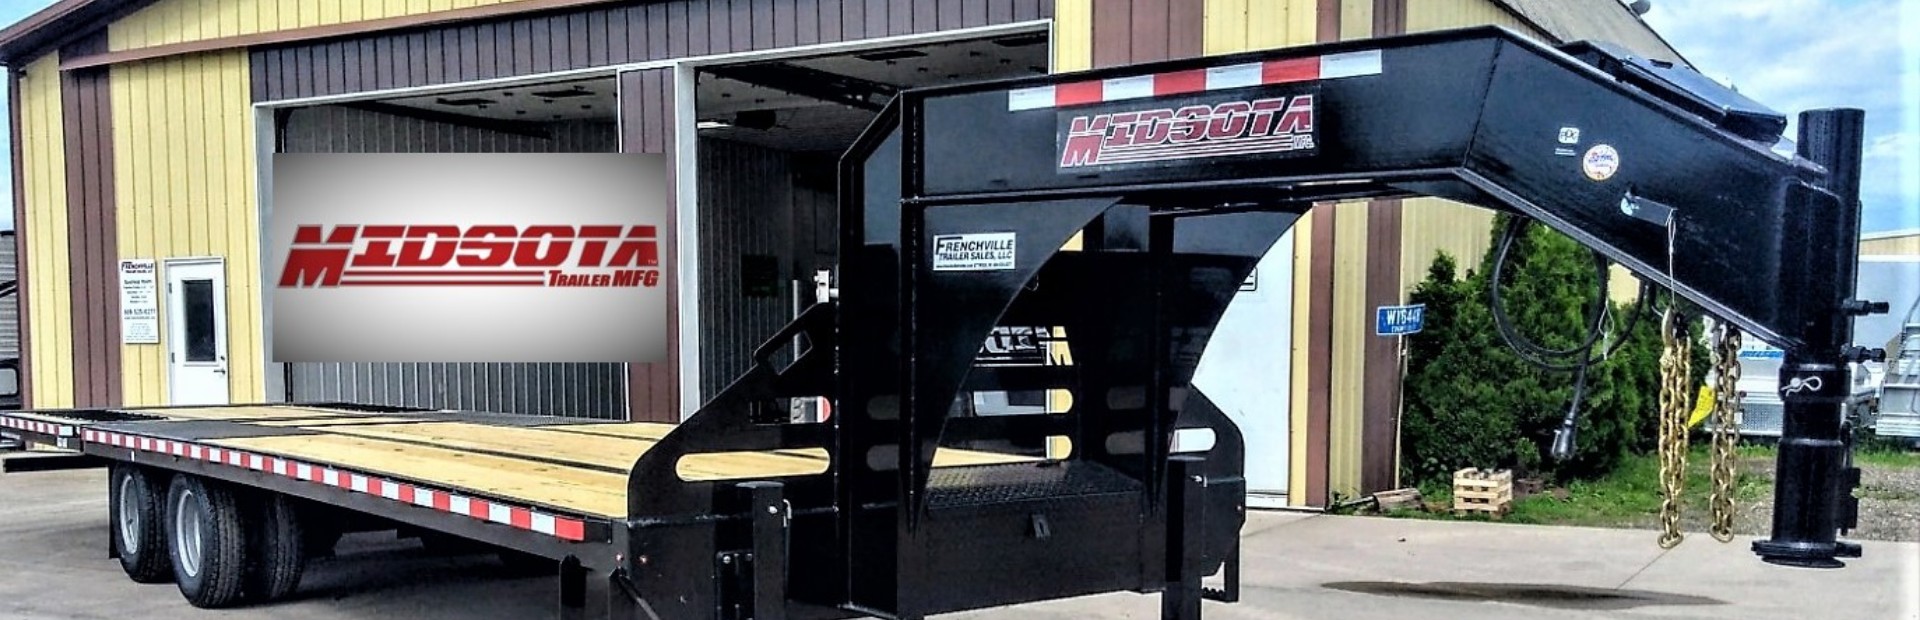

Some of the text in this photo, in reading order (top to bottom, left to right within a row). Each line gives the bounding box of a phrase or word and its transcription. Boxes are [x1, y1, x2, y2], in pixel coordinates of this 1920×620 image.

[1061, 94, 1313, 167] MIDSOTA
[935, 236, 1014, 255] FRENCHVILLE
[938, 251, 1013, 261] TRAILER SALES, LLC
